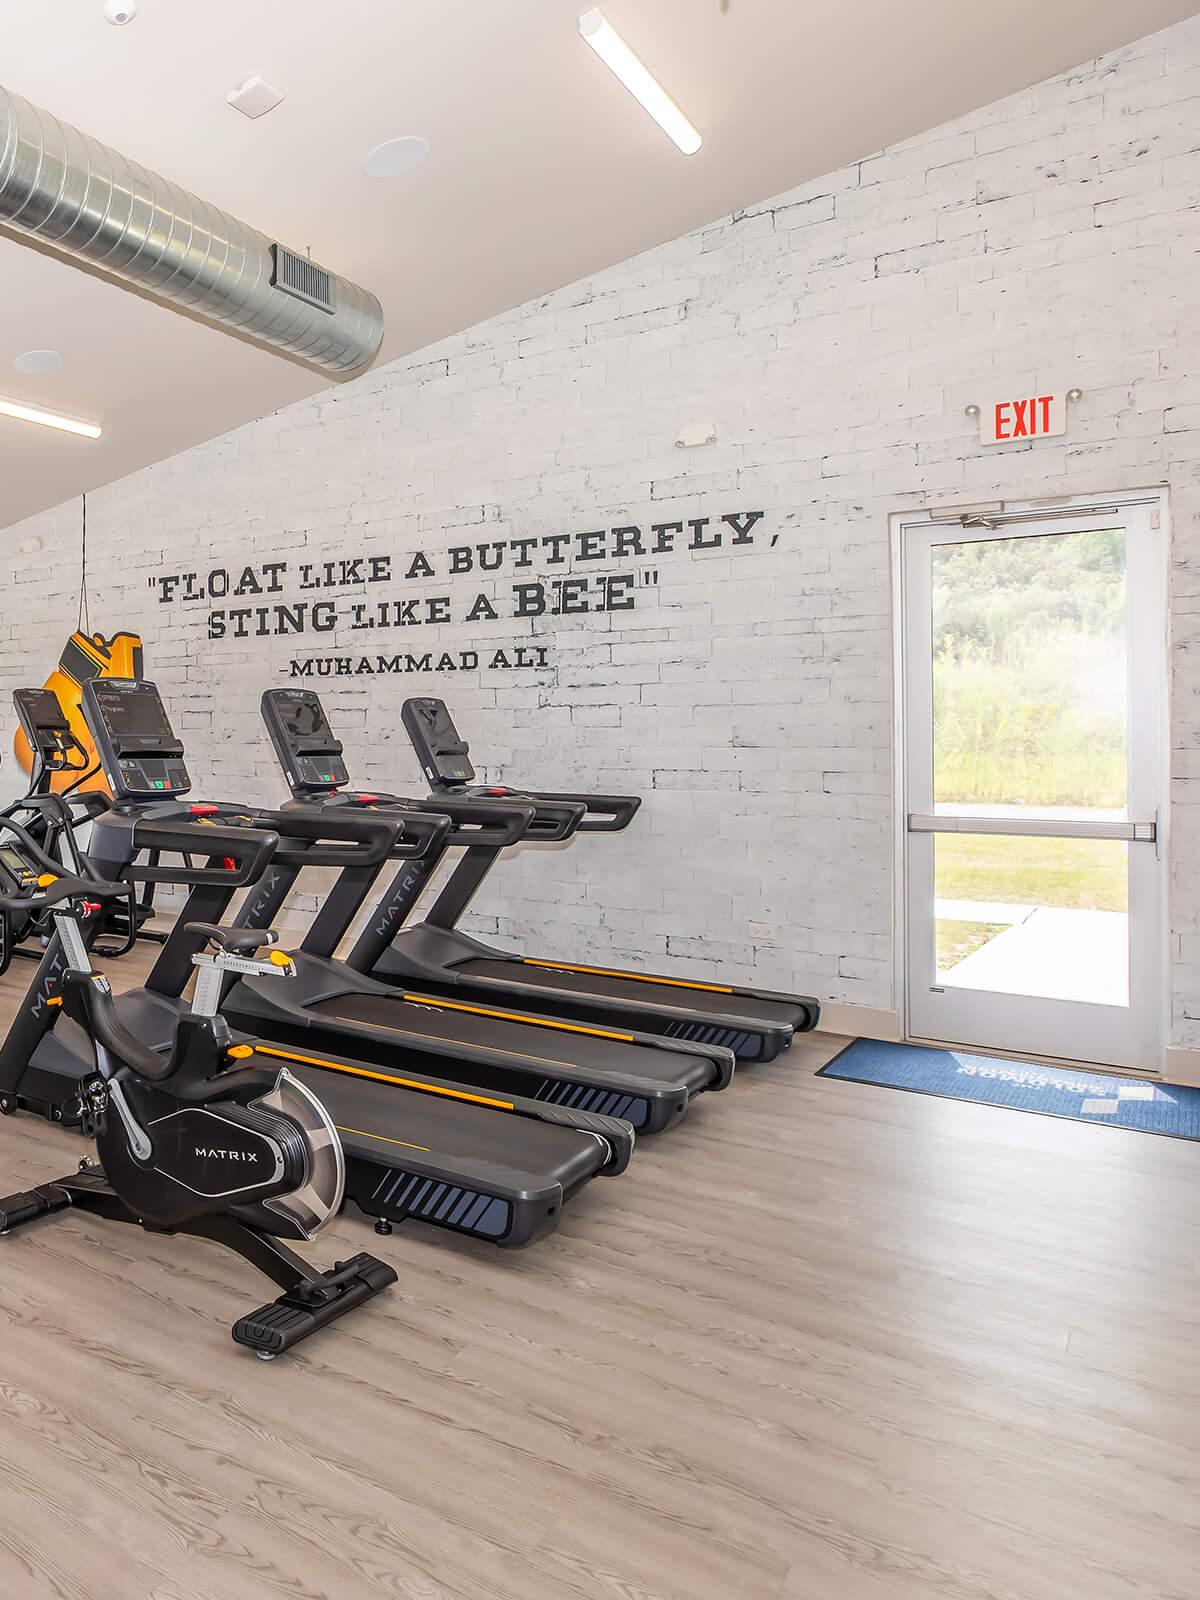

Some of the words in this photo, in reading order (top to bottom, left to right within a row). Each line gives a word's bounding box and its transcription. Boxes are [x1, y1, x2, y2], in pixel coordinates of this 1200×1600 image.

[995, 396, 1054, 440] EXIT
[299, 556, 392, 590] LIKE
[405, 551, 436, 579] A
[448, 511, 779, 575] BUTTERFLY,
[208, 602, 338, 640] STING
[351, 597, 451, 630] LIKE
[465, 594, 499, 622] A
[512, 571, 658, 618] BEE"
[488, 648, 549, 669] ALI
[242, 871, 280, 929] TRIX
[31, 953, 63, 1018] MAT
[195, 1147, 258, 1162] MATRIX
